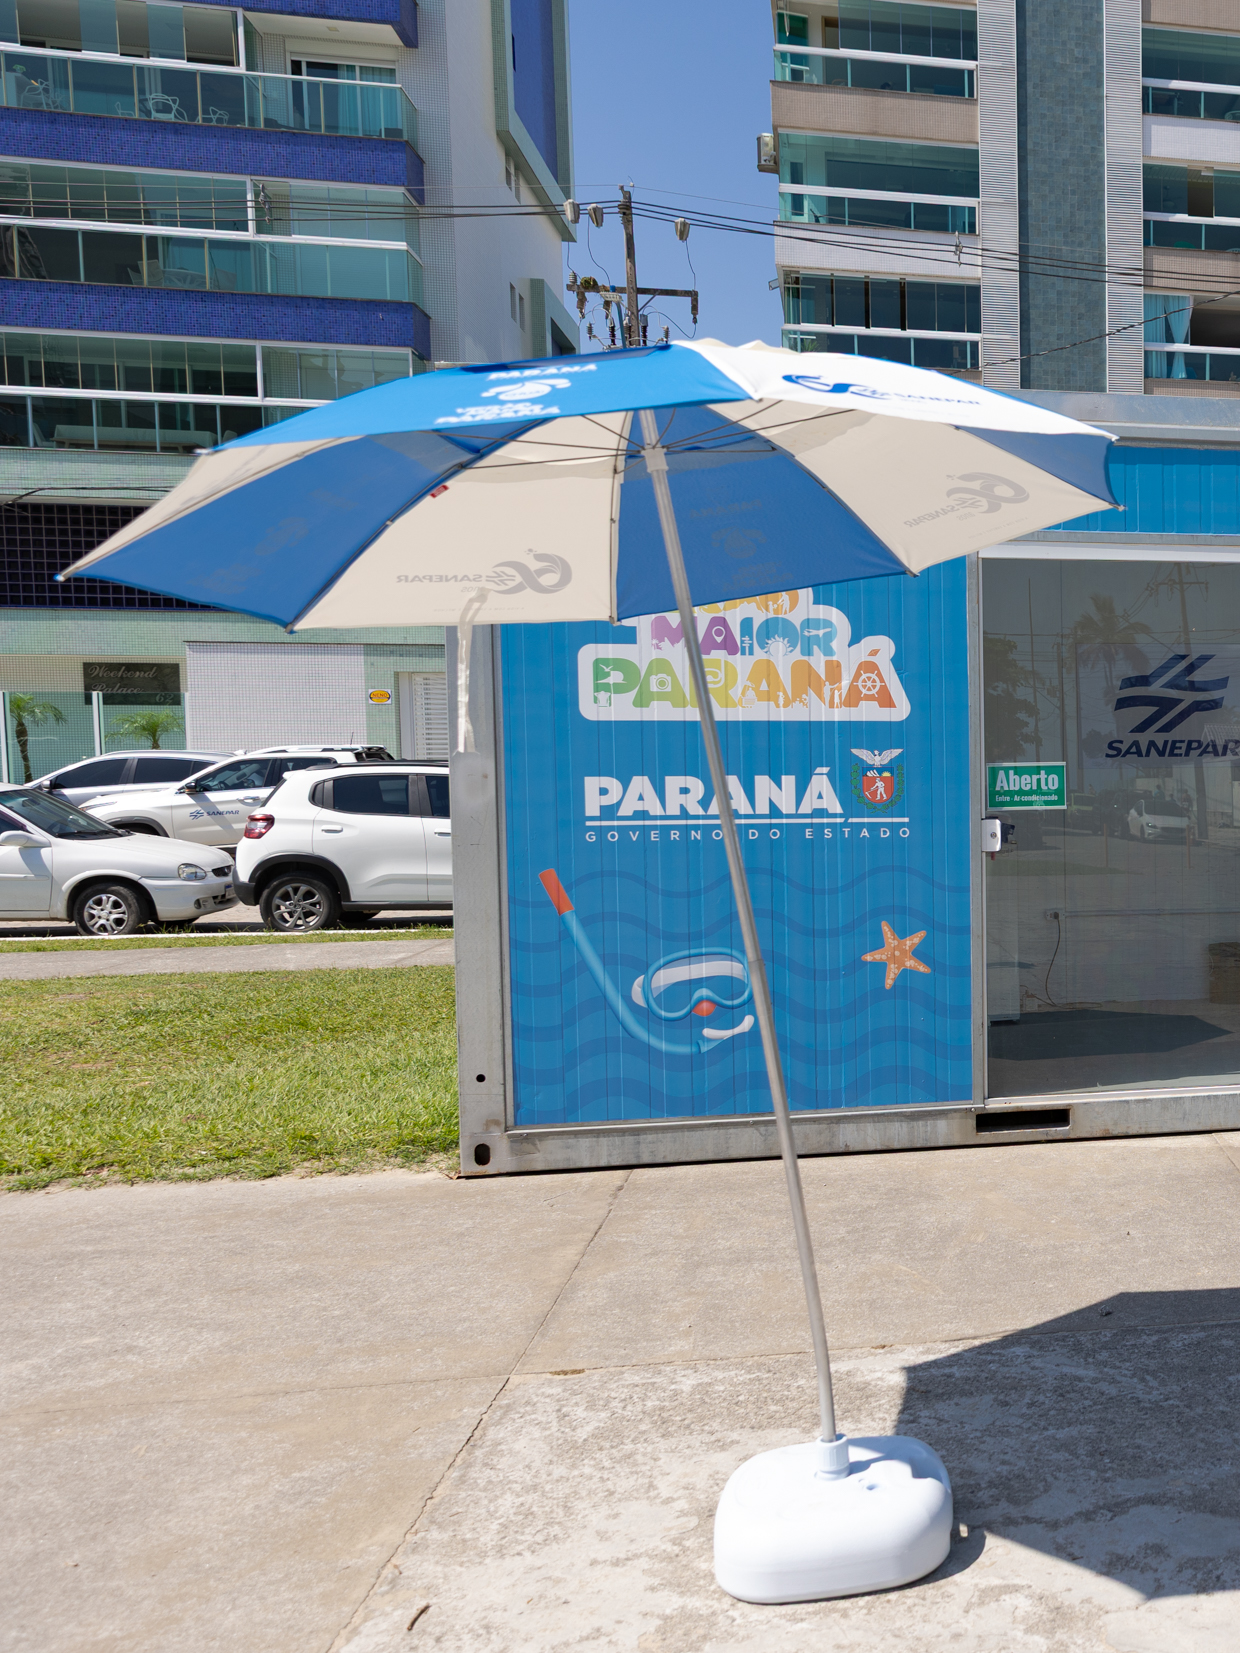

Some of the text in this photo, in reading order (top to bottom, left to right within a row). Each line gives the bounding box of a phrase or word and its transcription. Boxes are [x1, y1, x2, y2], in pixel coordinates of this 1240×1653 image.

[650, 614, 838, 657] MAIOR
[88, 664, 158, 678] Weekend
[592, 647, 898, 709] PARANÁ
[995, 769, 1059, 791] Aberto
[583, 766, 845, 817] PARANÁ
[995, 794, 1011, 802] Entre
[1013, 793, 1058, 802] Ar-condicionado
[584, 827, 911, 843] GOVERNO DO ESTADO
